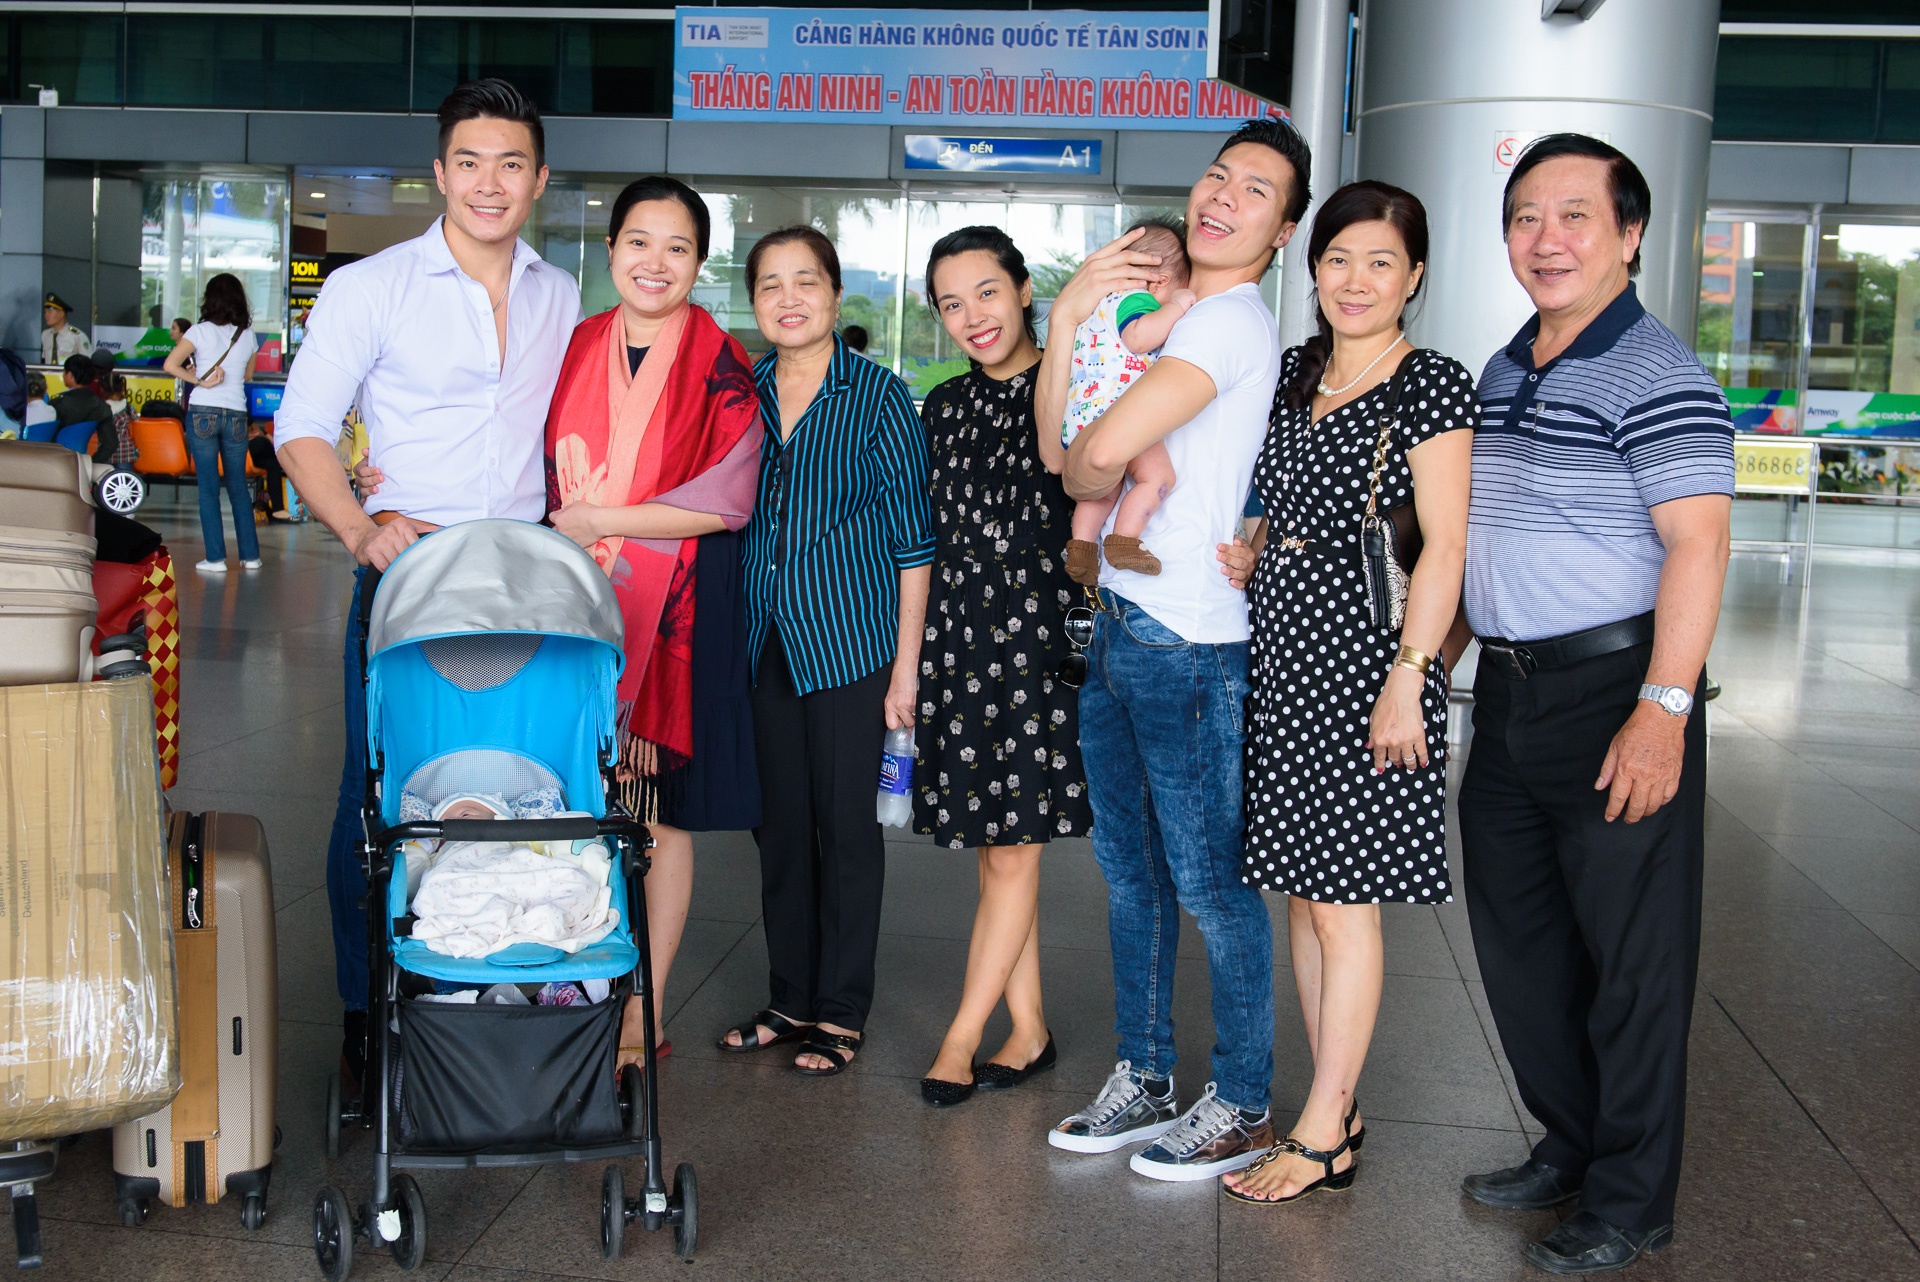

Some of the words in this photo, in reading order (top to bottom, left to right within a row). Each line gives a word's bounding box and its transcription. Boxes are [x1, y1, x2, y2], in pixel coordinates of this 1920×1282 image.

[686, 24, 721, 40] TIA
[795, 19, 852, 45] CẢNG
[858, 22, 916, 46] HÀNG
[922, 23, 995, 47] KHÔNG
[1002, 21, 1059, 49] QUỐC
[1065, 22, 1093, 48] TẾ
[1097, 25, 1139, 49] TÂN
[1146, 28, 1191, 49] SƠN
[689, 65, 771, 110] THÁNG
[776, 74, 813, 111] AN
[818, 75, 883, 112] NINH
[904, 76, 942, 113] AN
[948, 69, 1016, 114] TOÀN
[1022, 70, 1095, 115] HÀNG
[1100, 71, 1192, 117] KHÔNG
[969, 141, 993, 154] ĐẾN
[1058, 145, 1091, 168] A1
[969, 157, 999, 166] Arrival
[96, 340, 122, 350] Amway
[1807, 406, 1839, 418] Amway
[19, 860, 32, 918] Deutschland
